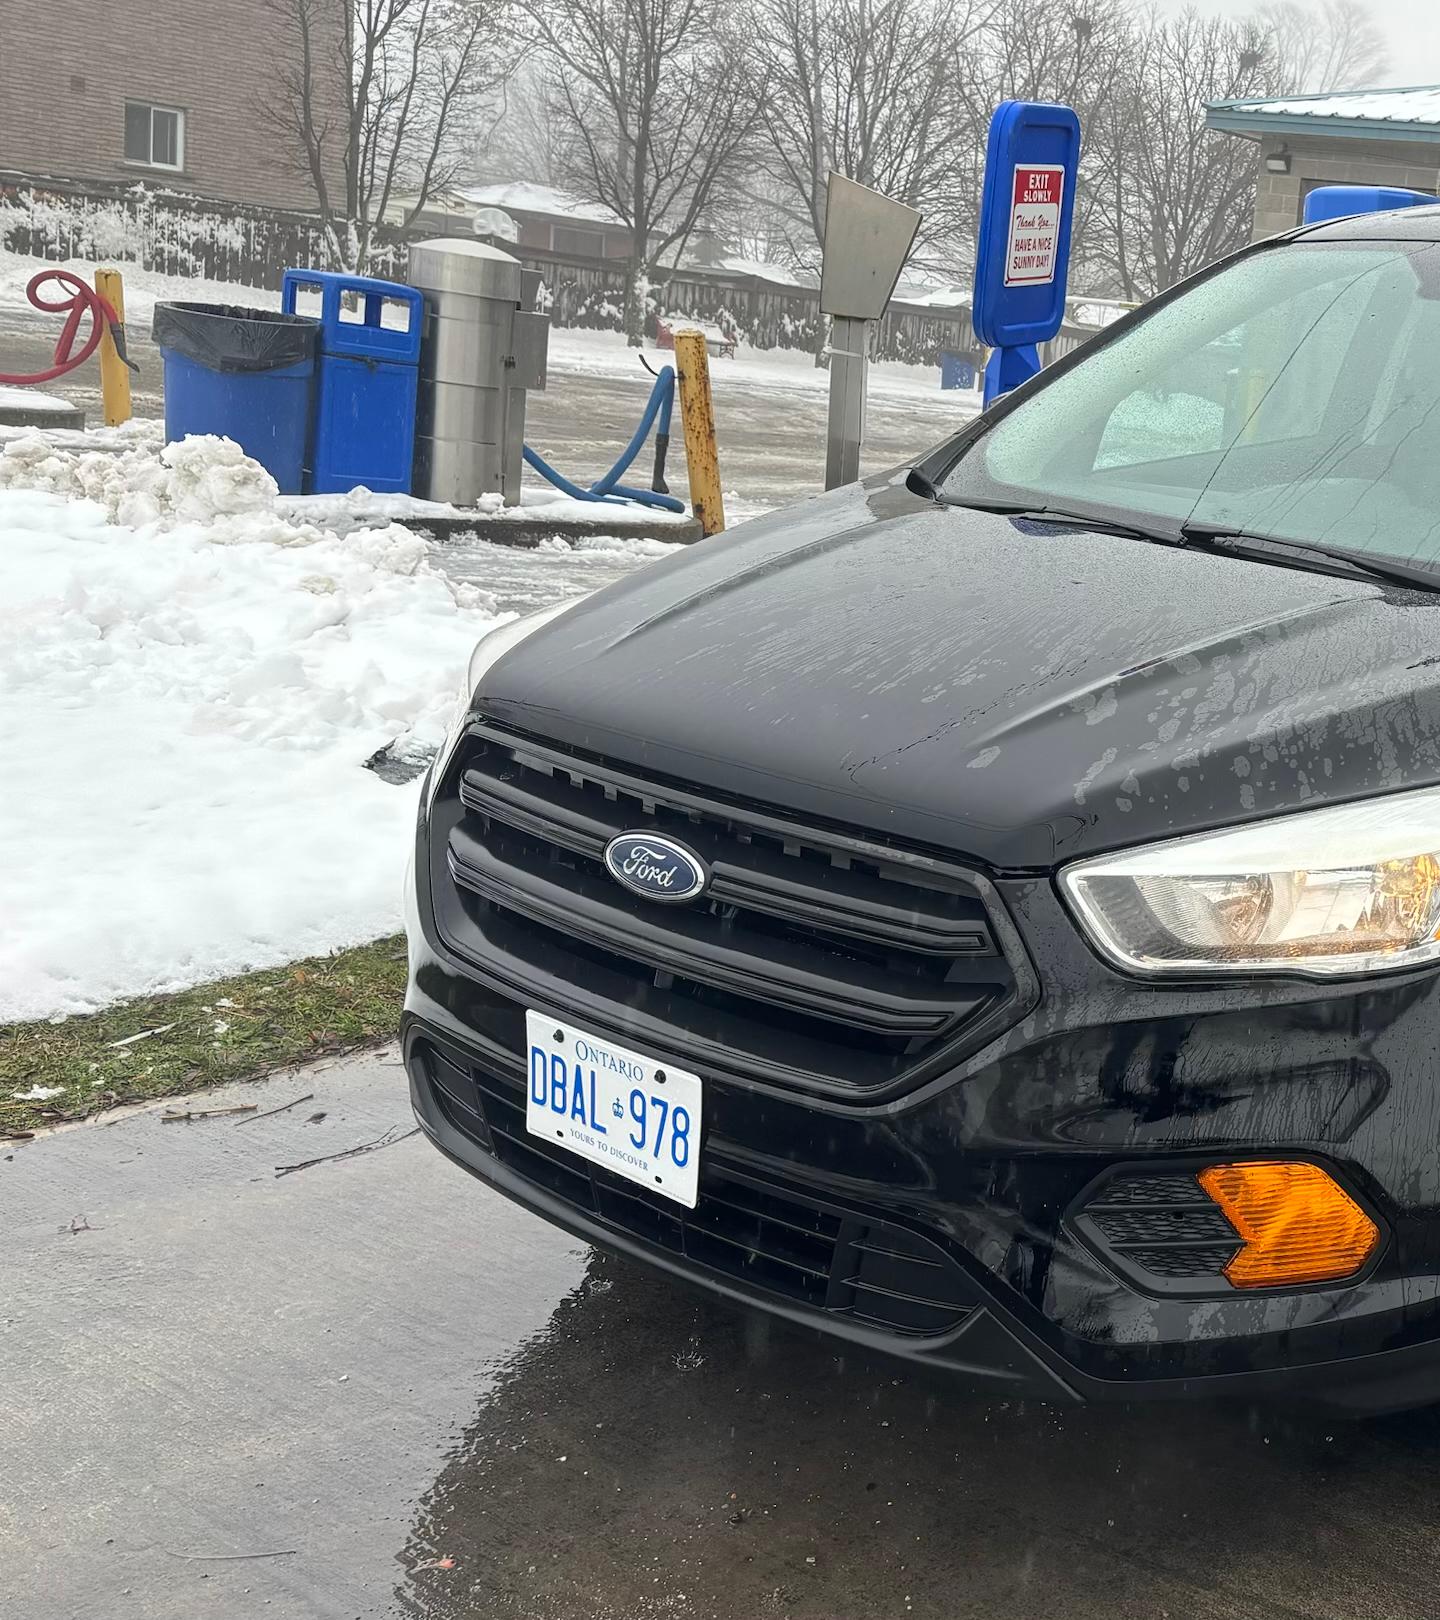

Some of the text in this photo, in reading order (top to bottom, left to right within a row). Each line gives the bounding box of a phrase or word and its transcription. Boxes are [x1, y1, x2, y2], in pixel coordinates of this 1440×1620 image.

[1029, 174, 1049, 189] EXIT
[1023, 190, 1052, 202] SLOWLY
[1016, 214, 1035, 228] Thank
[1014, 237, 1052, 252] HAVE A NICE
[1013, 255, 1035, 270] SUNNY
[623, 845, 678, 888] Ford
[575, 1040, 644, 1082] ONTARIO
[531, 1045, 690, 1168] DBAL 978
[569, 1128, 649, 1171] YOURS TO DISCOVER
